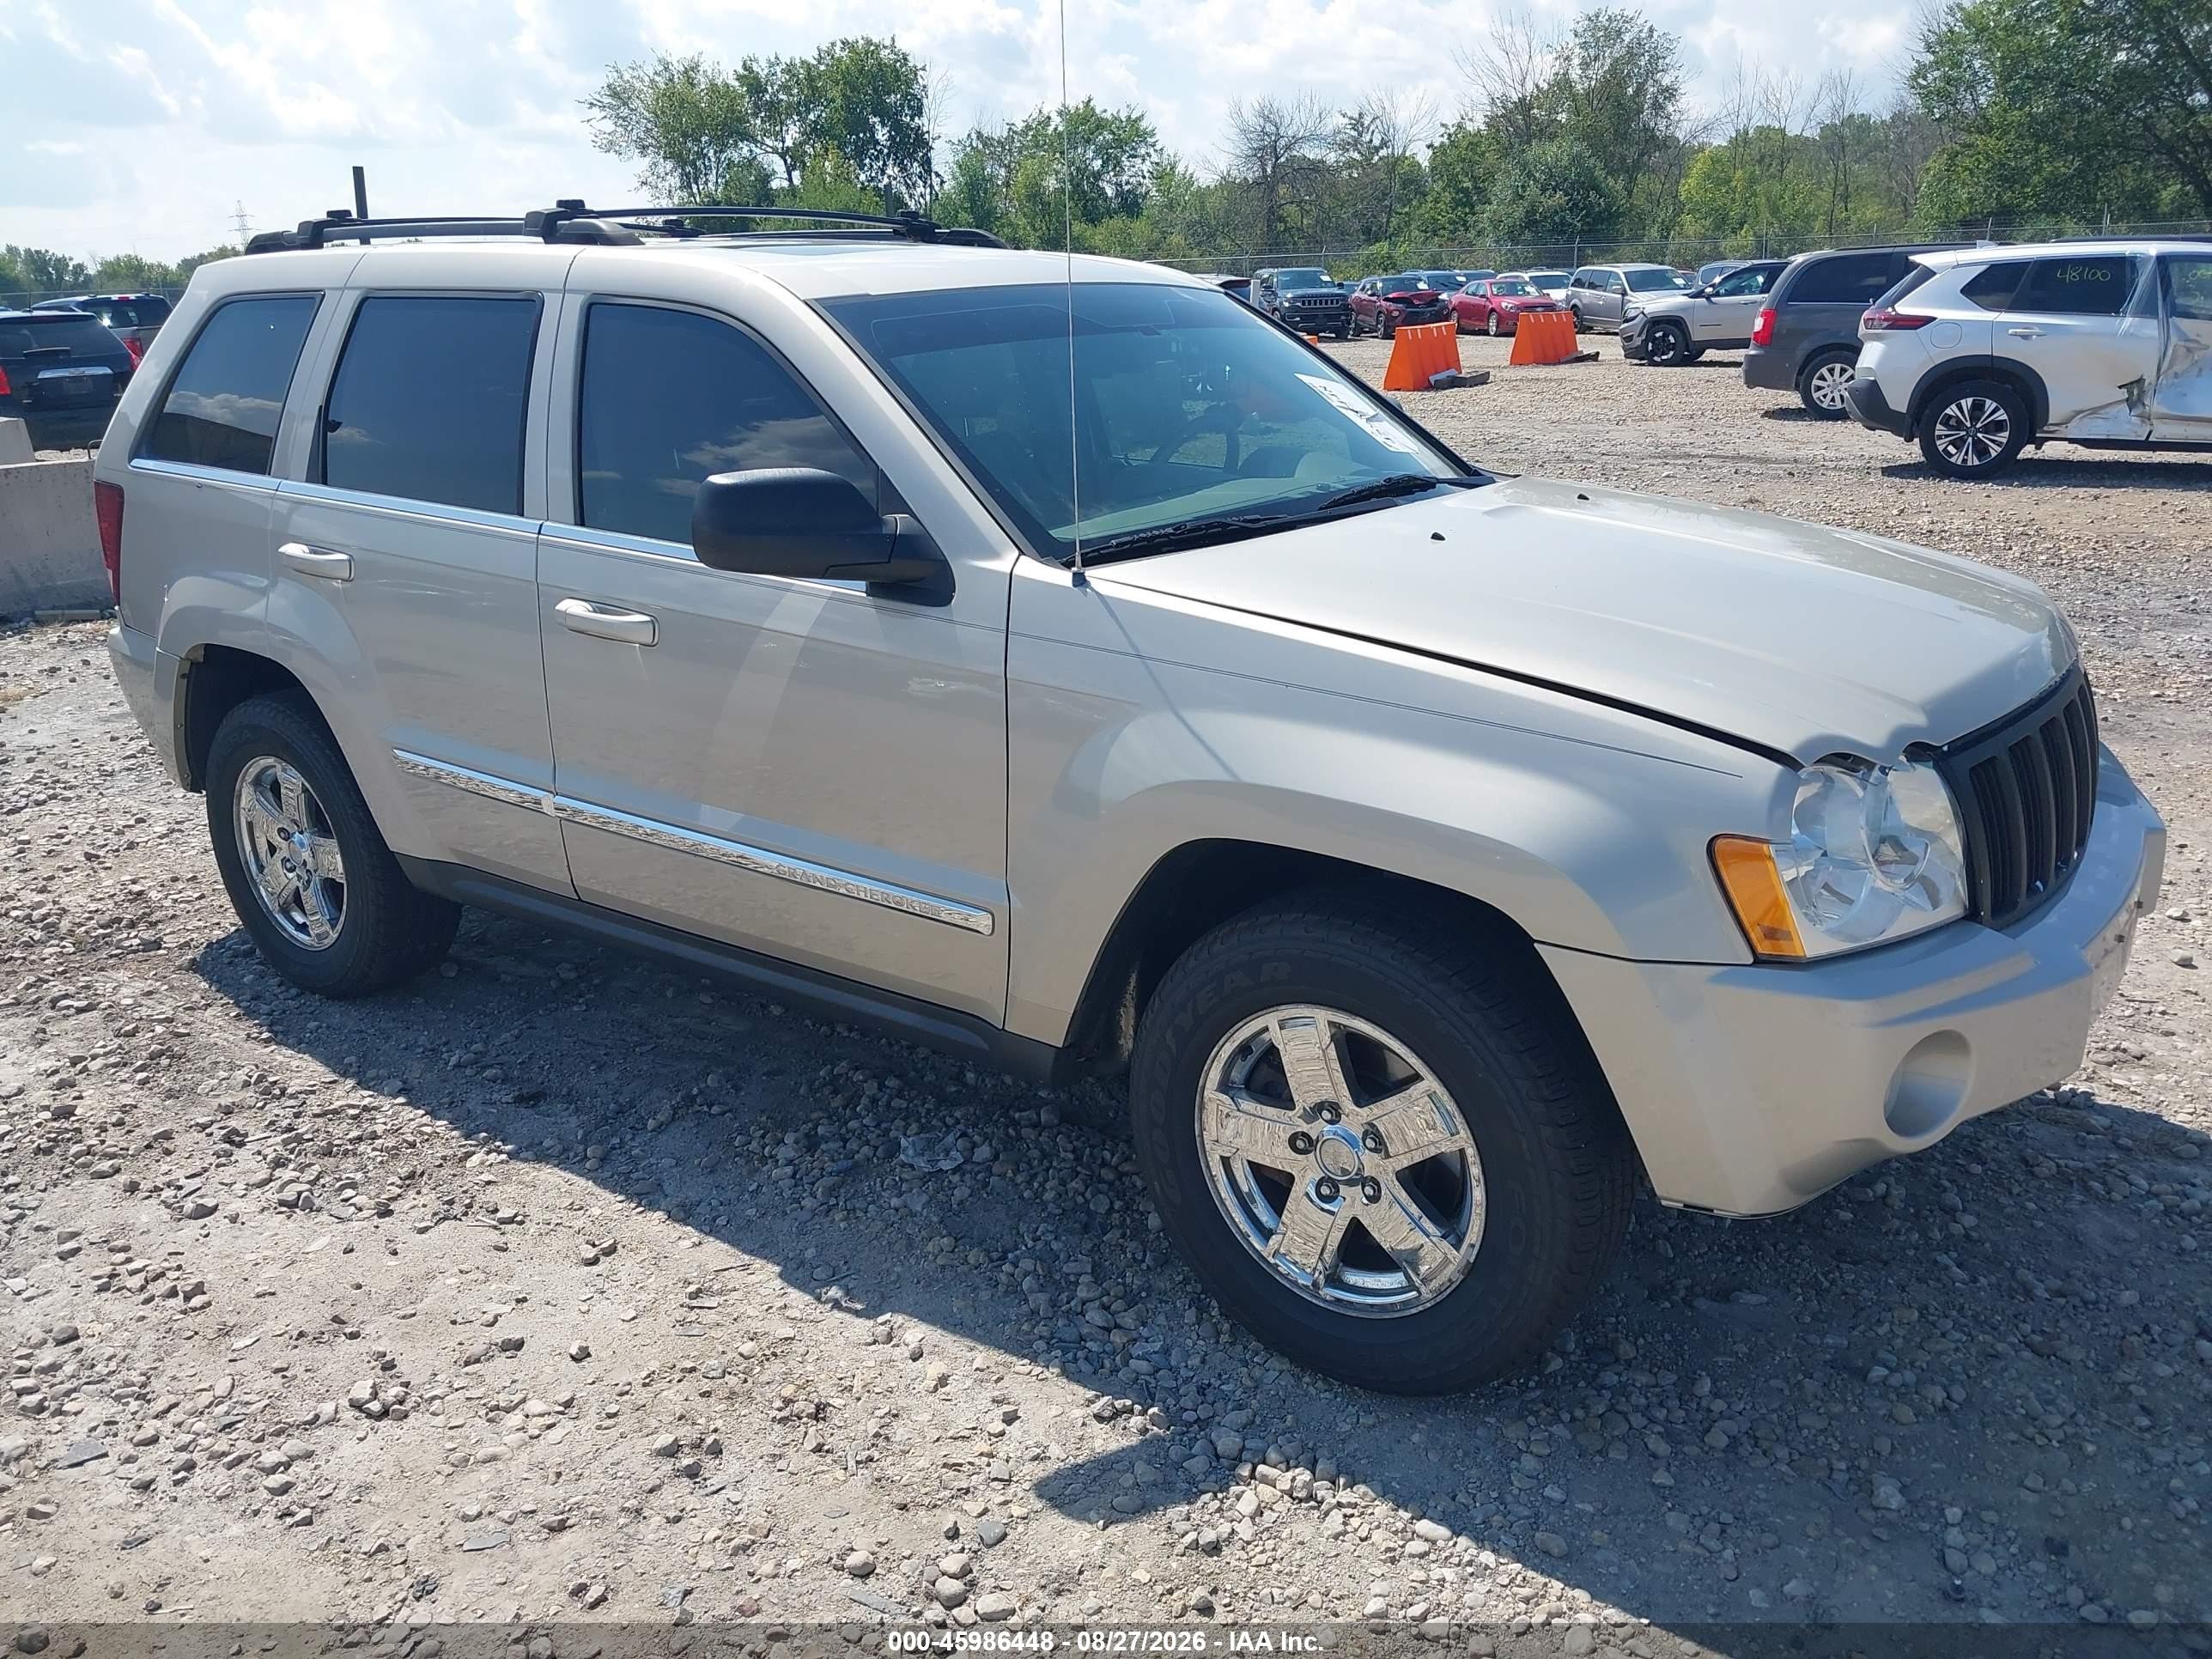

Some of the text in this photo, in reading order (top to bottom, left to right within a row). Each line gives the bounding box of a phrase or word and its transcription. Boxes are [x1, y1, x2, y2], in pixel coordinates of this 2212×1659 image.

[2057, 264, 2112, 284] 48100
[775, 862, 943, 916] GRAND CHEROKEE
